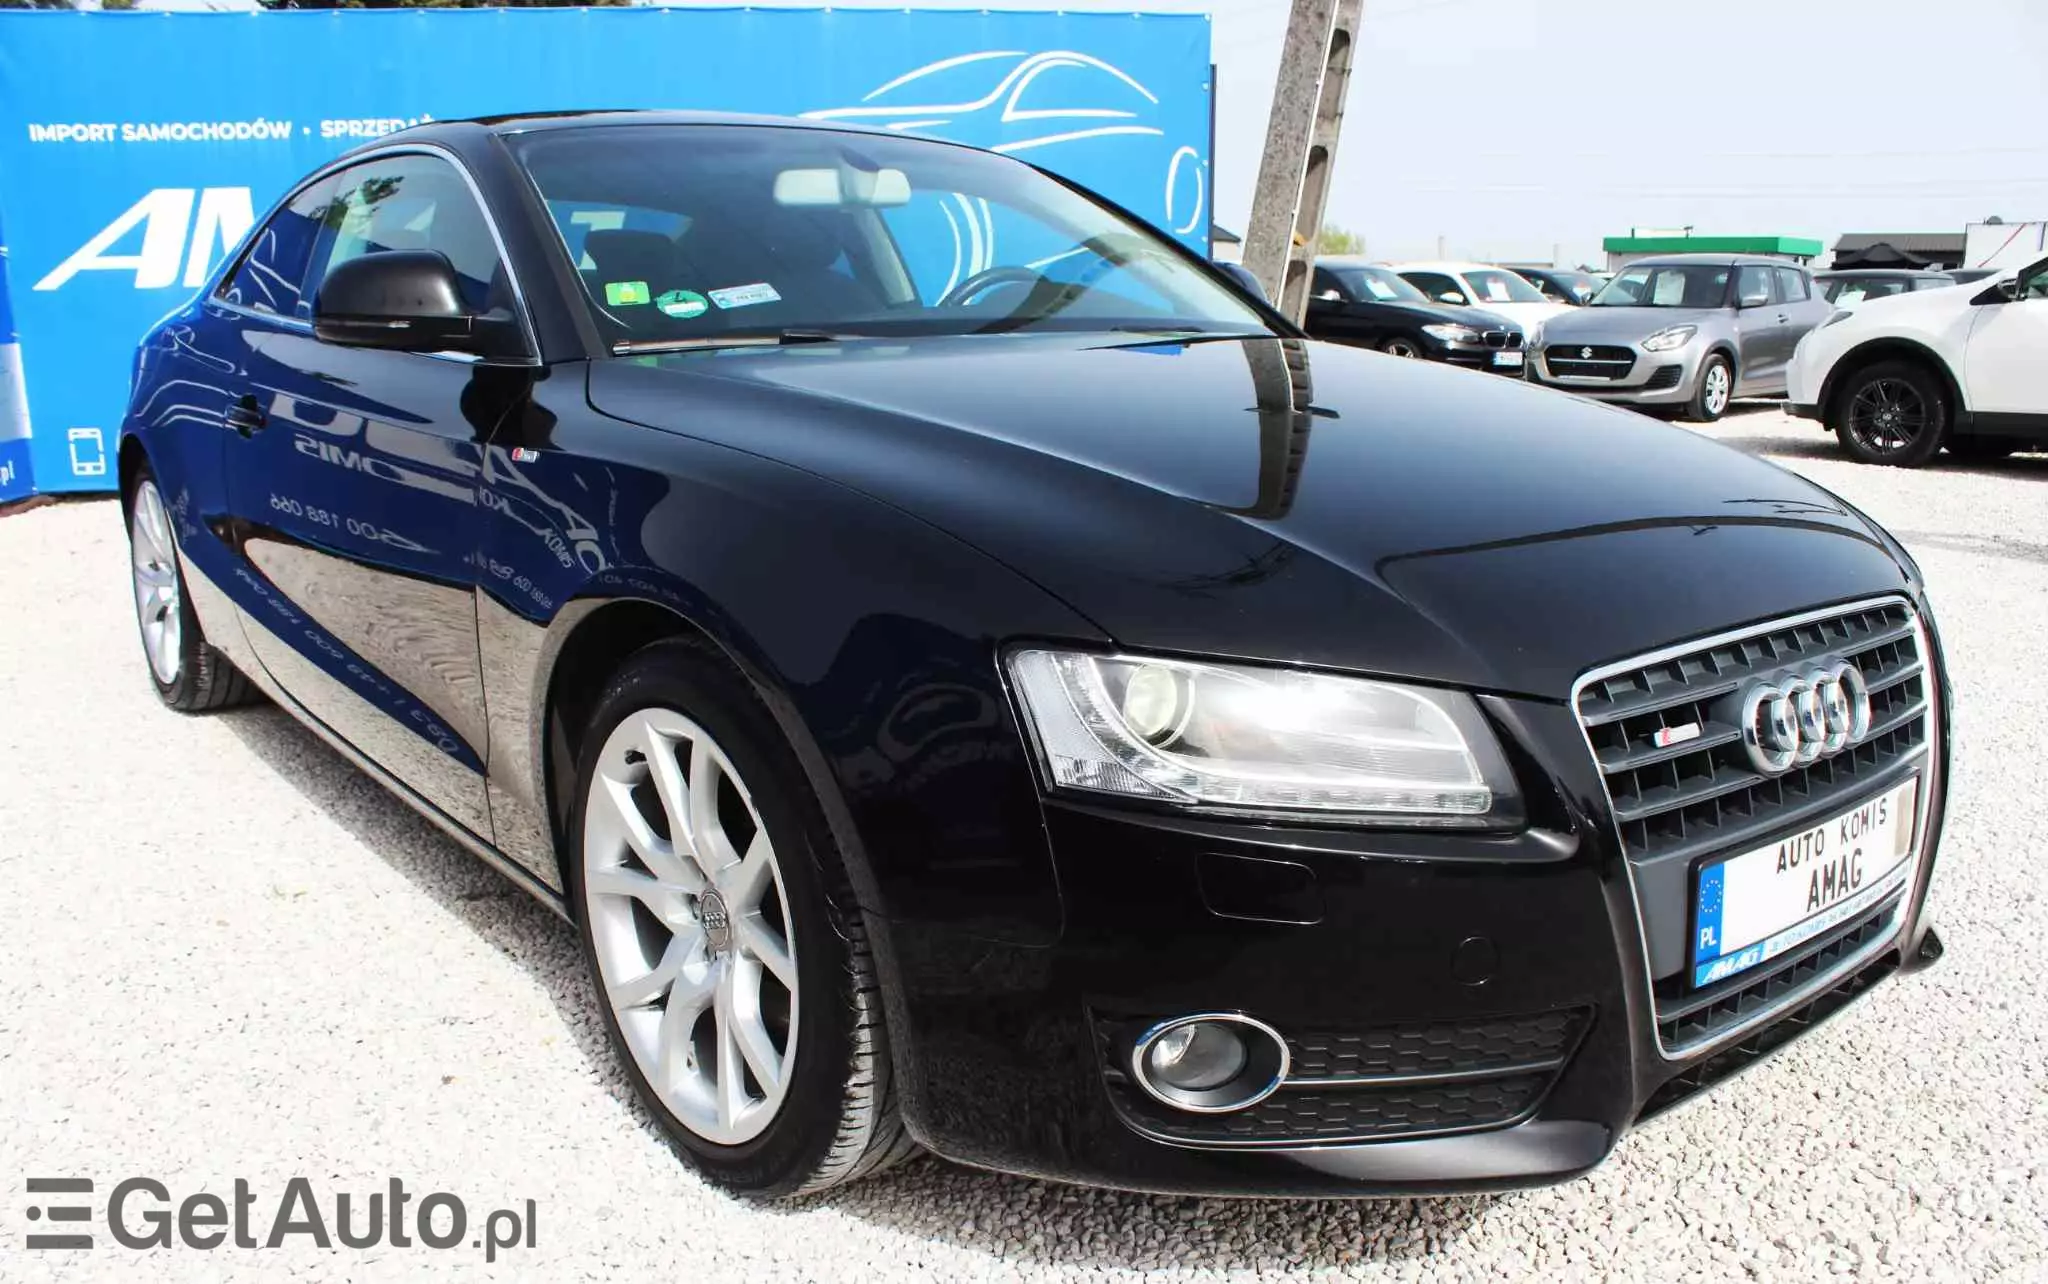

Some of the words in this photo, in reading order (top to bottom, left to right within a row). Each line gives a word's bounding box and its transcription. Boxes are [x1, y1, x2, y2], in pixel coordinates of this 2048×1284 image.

[29, 123, 117, 143] IMPORT
[121, 117, 292, 142] SAMOCHODÓW
[1776, 828, 1825, 874] AUTO
[1840, 798, 1888, 846] KOMIS
[1807, 848, 1863, 912] AMAG
[1700, 926, 1718, 950] PL
